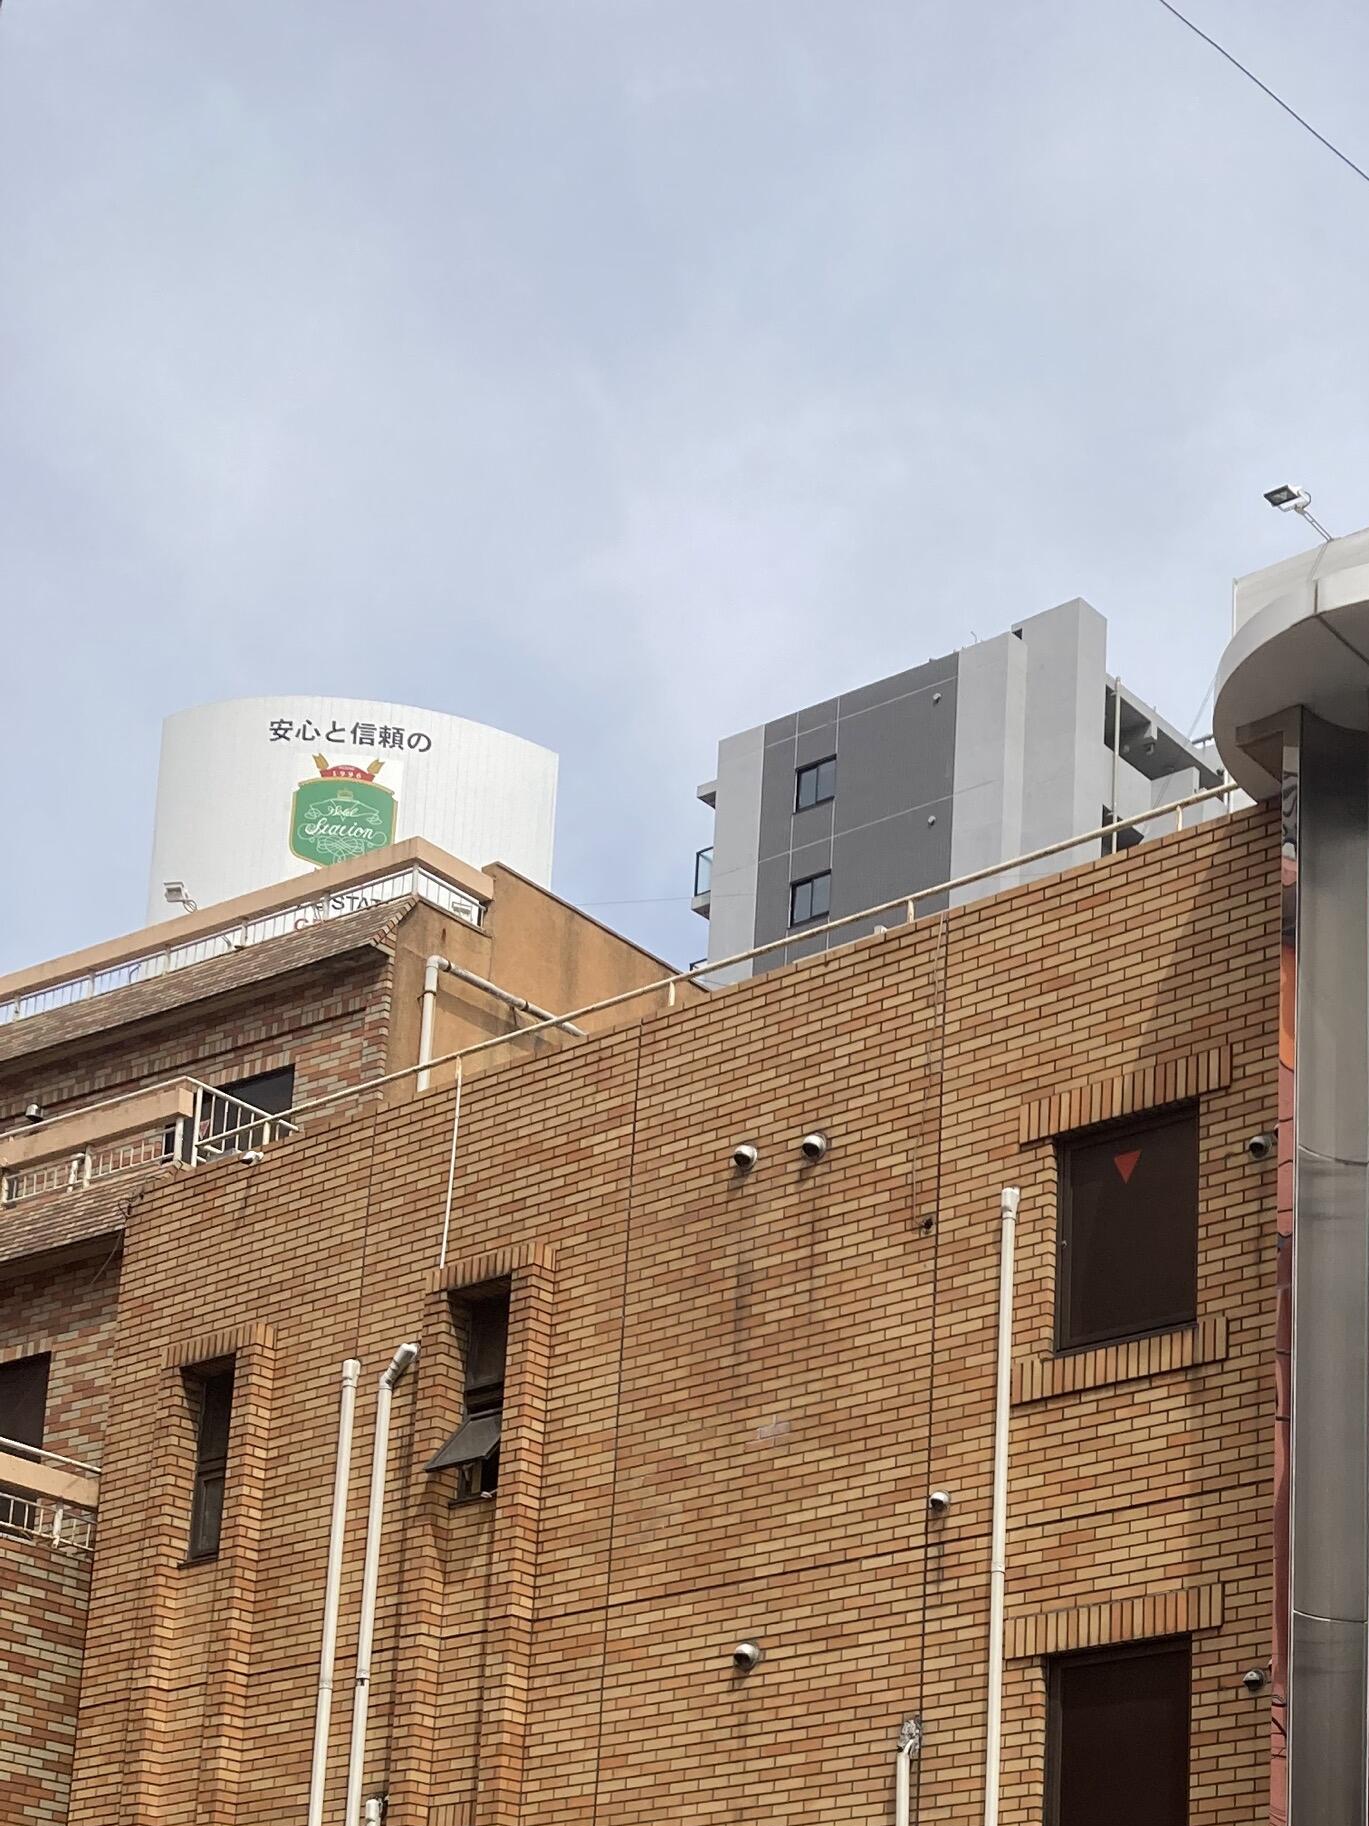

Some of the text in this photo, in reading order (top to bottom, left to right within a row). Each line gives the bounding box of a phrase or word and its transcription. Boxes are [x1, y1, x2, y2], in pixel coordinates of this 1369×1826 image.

[269, 718, 432, 753] 安心と信頼の
